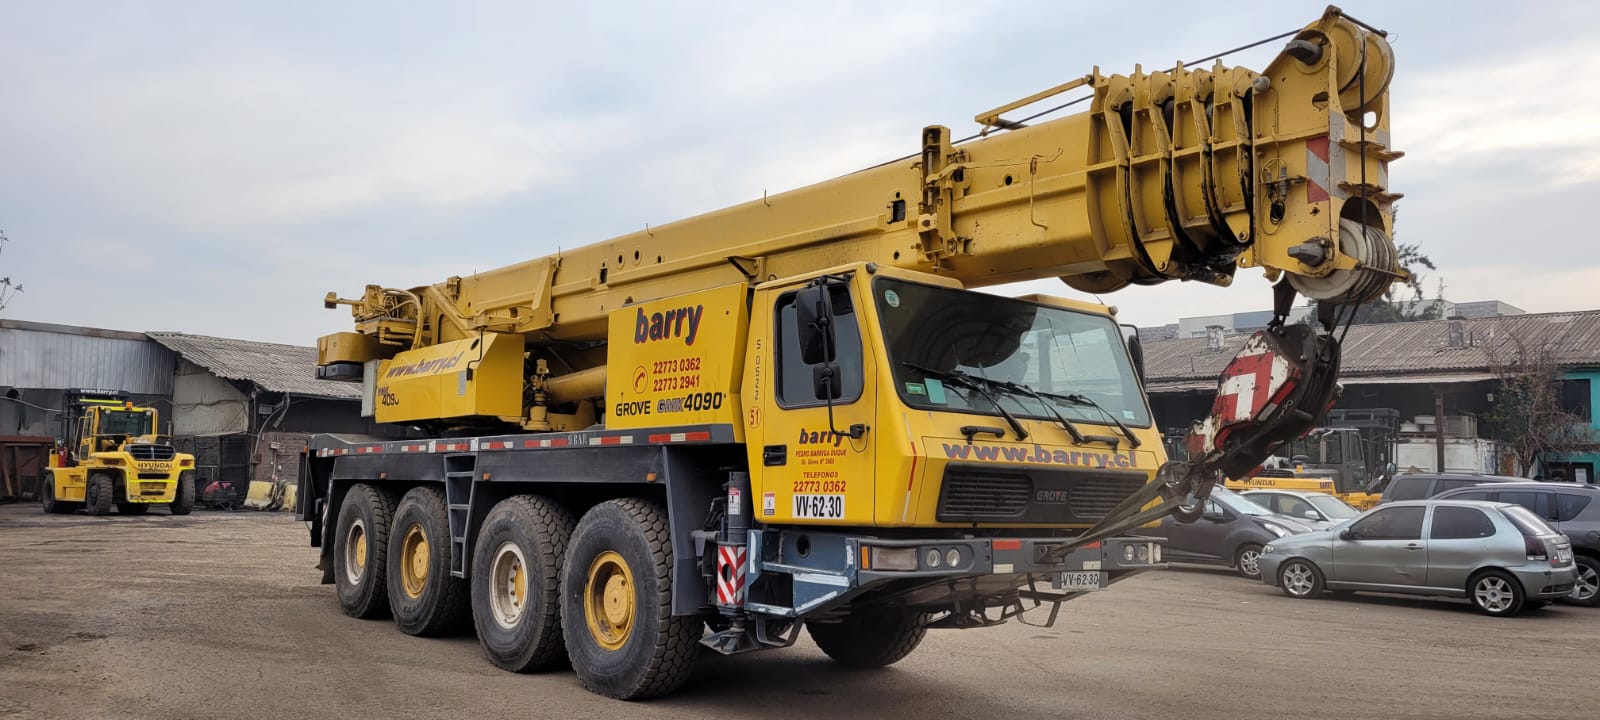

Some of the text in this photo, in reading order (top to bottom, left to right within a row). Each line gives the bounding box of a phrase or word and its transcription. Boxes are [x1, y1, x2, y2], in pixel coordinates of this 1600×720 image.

[634, 305, 703, 346] barry
[386, 350, 464, 378] www.barry.cl
[653, 357, 701, 375] 22773 0362
[653, 375, 701, 393] 22773 2941
[616, 400, 651, 416] GROVE
[750, 409, 760, 426] 51
[799, 428, 845, 448] barry
[942, 443, 1137, 468] www.barry.cl
[803, 471, 839, 479] TELEFONOS
[793, 480, 846, 493] 22773 0362
[1036, 490, 1068, 502] GROVE
